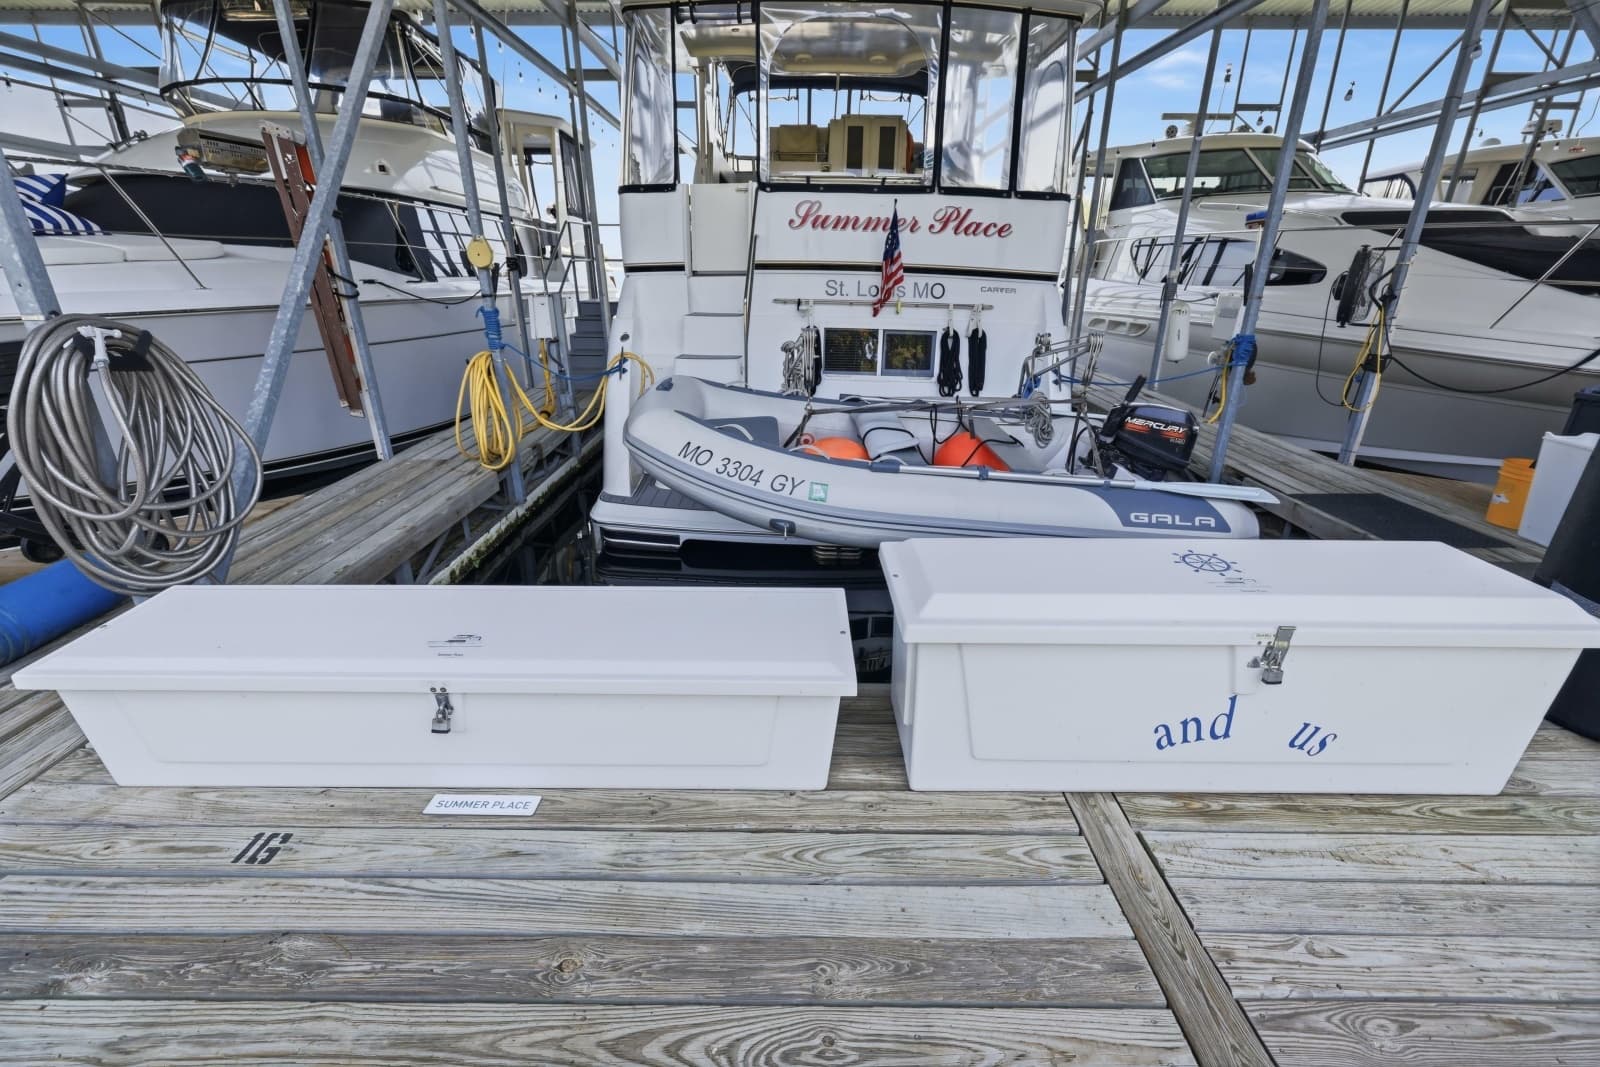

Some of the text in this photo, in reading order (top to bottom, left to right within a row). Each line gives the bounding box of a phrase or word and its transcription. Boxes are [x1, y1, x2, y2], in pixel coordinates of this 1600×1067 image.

[788, 200, 1013, 238] Summer Place
[825, 280, 849, 297] St.
[913, 282, 946, 300] MO
[1124, 416, 1187, 434] MERCURY
[678, 441, 806, 496] MO 3304 GY
[1129, 512, 1216, 528] GALA
[1153, 694, 1338, 757] and us
[435, 800, 532, 810] SUMMER PLACE
